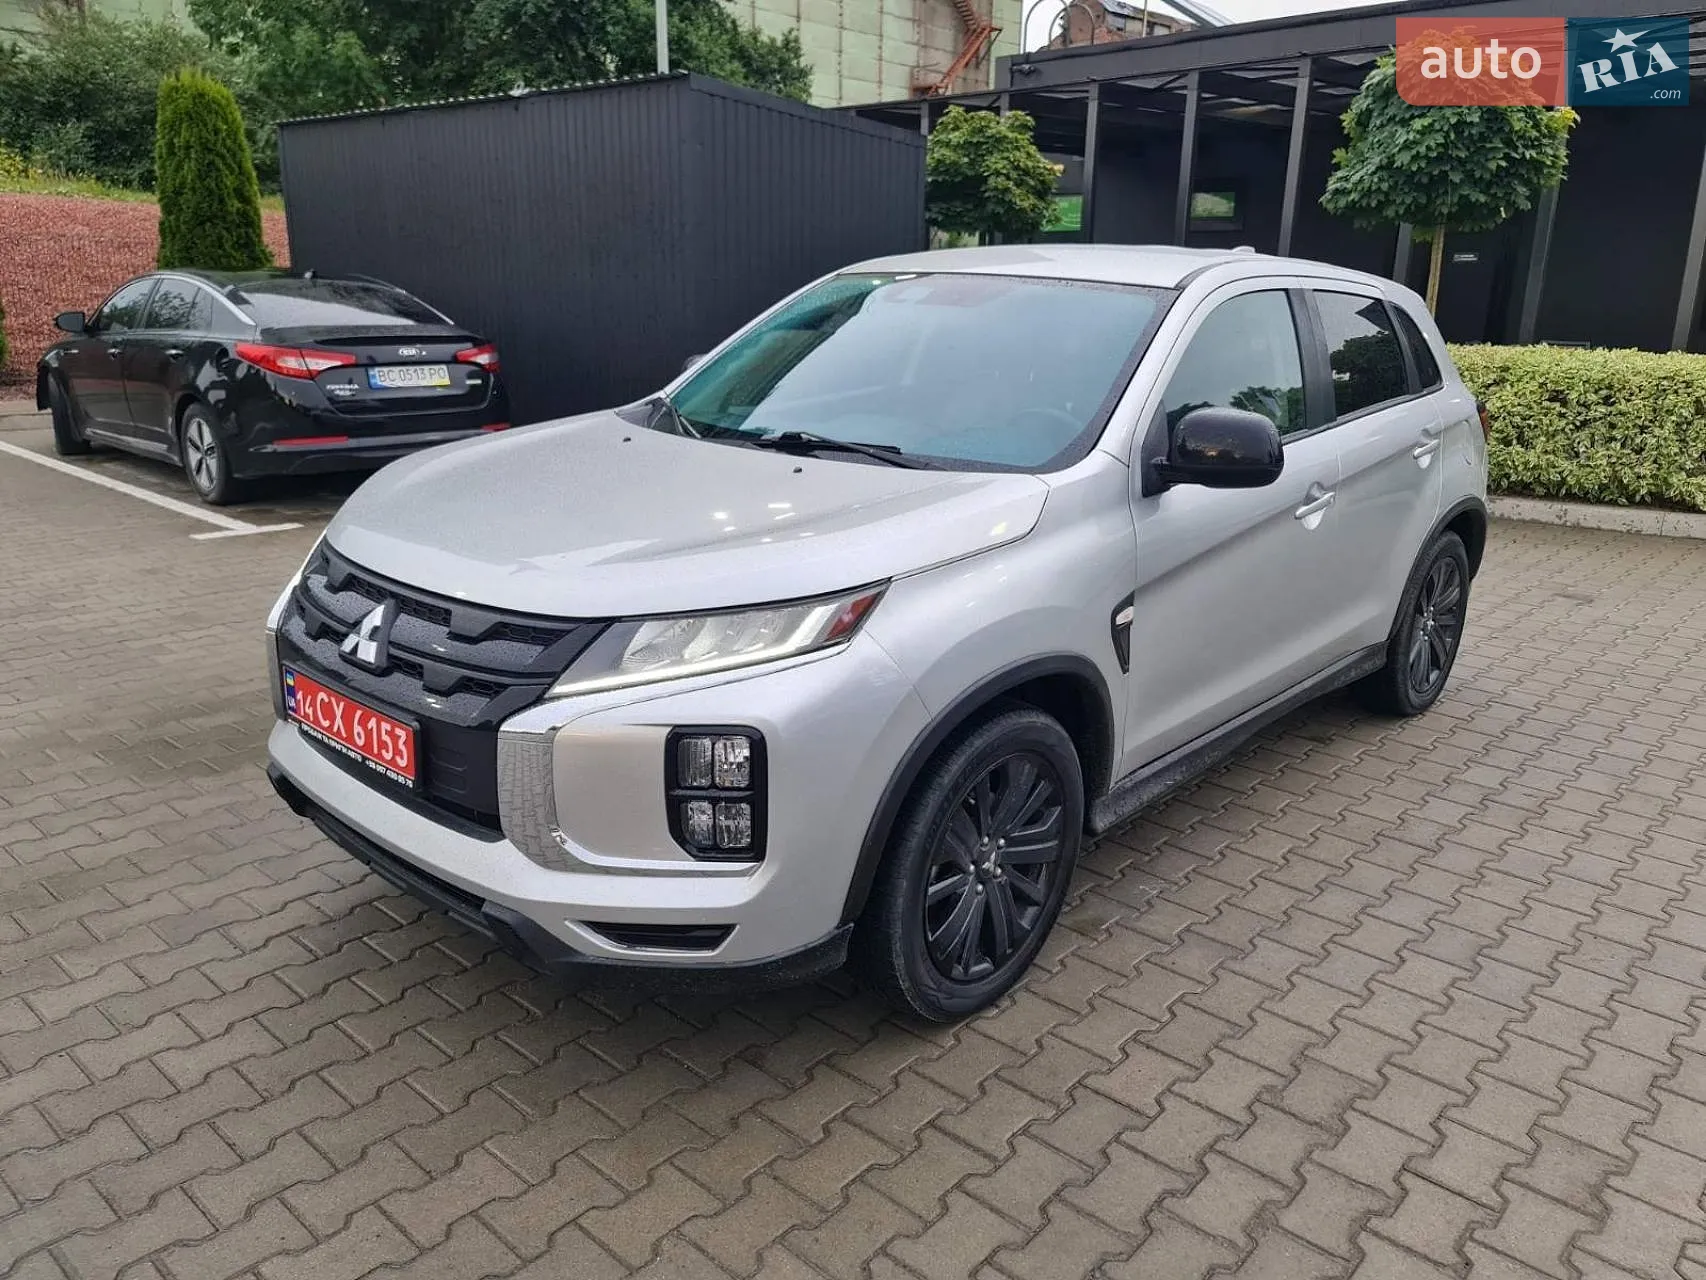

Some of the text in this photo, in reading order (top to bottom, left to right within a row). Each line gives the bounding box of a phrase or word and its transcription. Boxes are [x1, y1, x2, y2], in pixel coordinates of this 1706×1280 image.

[378, 369, 395, 382] BC
[399, 367, 426, 381] 0513
[353, 709, 408, 768] 6153
